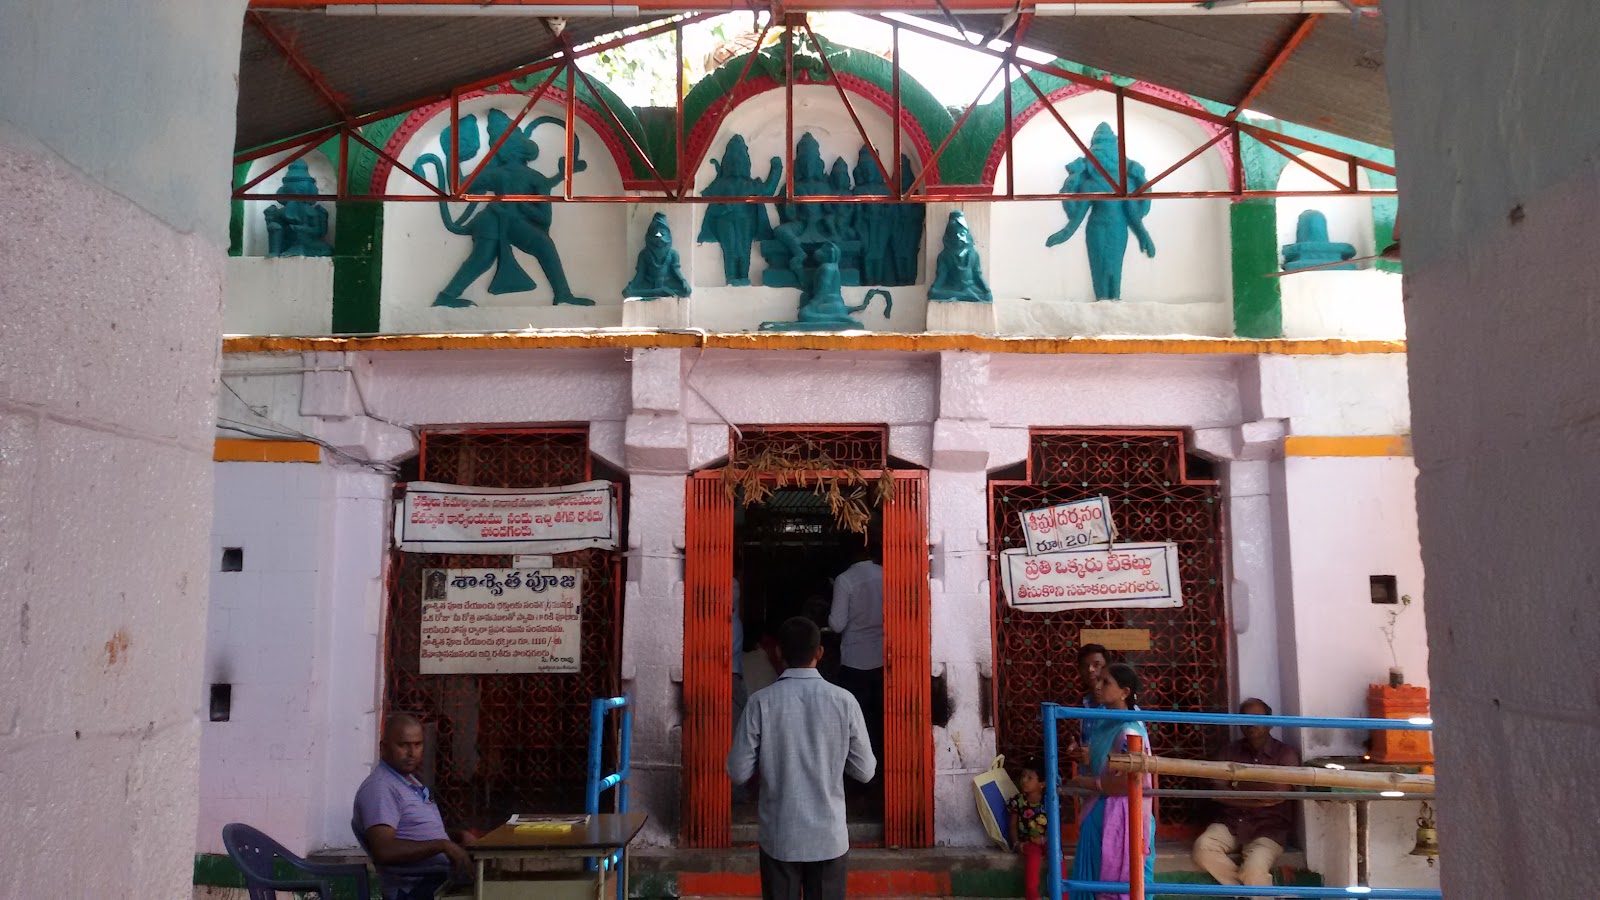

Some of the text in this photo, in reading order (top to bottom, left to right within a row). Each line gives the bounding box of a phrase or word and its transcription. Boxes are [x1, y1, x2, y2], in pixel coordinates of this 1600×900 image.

[1057, 506, 1103, 529] దర్శనం
[1065, 529, 1099, 547] 20/-
[1025, 560, 1051, 580] ప్రతి
[1055, 556, 1103, 578] ఒక్కరు
[525, 571, 575, 593] పూజ
